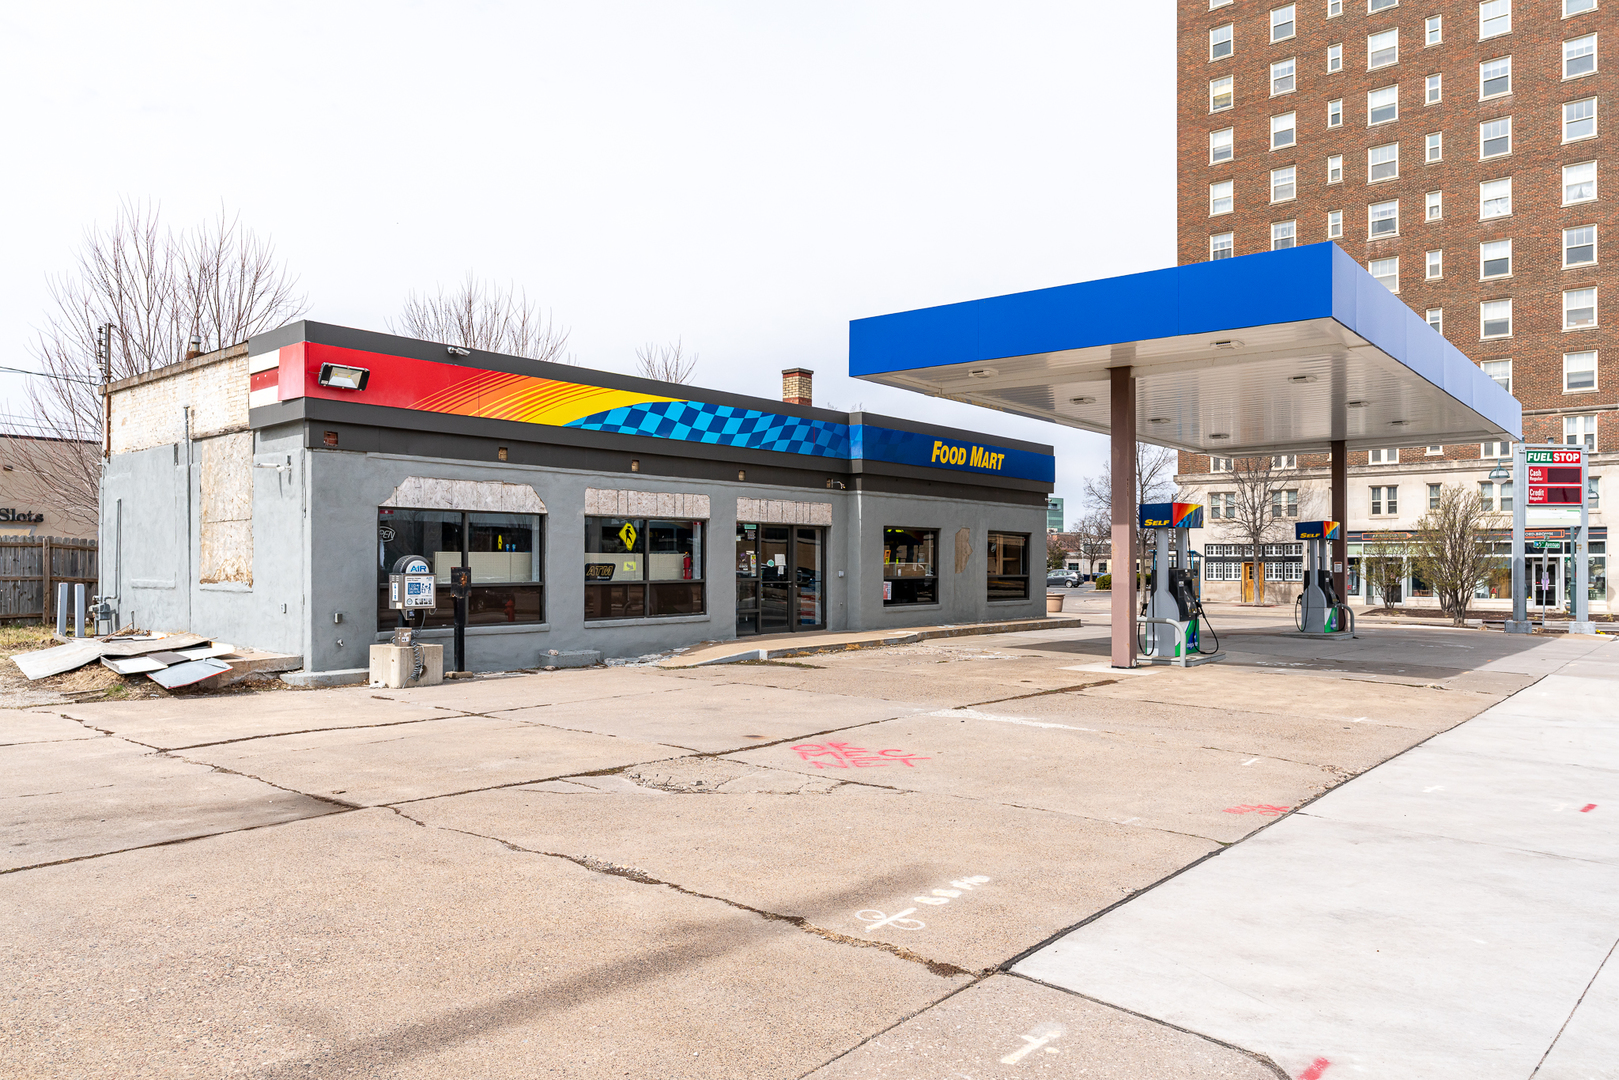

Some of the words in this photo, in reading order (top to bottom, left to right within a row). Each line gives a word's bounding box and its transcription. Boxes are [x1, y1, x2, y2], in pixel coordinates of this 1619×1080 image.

[931, 441, 967, 465] FOOD
[969, 446, 1005, 470] MART
[1527, 453, 1552, 461] FUEL
[1553, 453, 1579, 461] STOP
[0, 508, 44, 523] Slots
[1144, 518, 1171, 527] SELF
[379, 529, 395, 540] PEN
[410, 565, 427, 573] AIR
[586, 565, 614, 577] ATM
